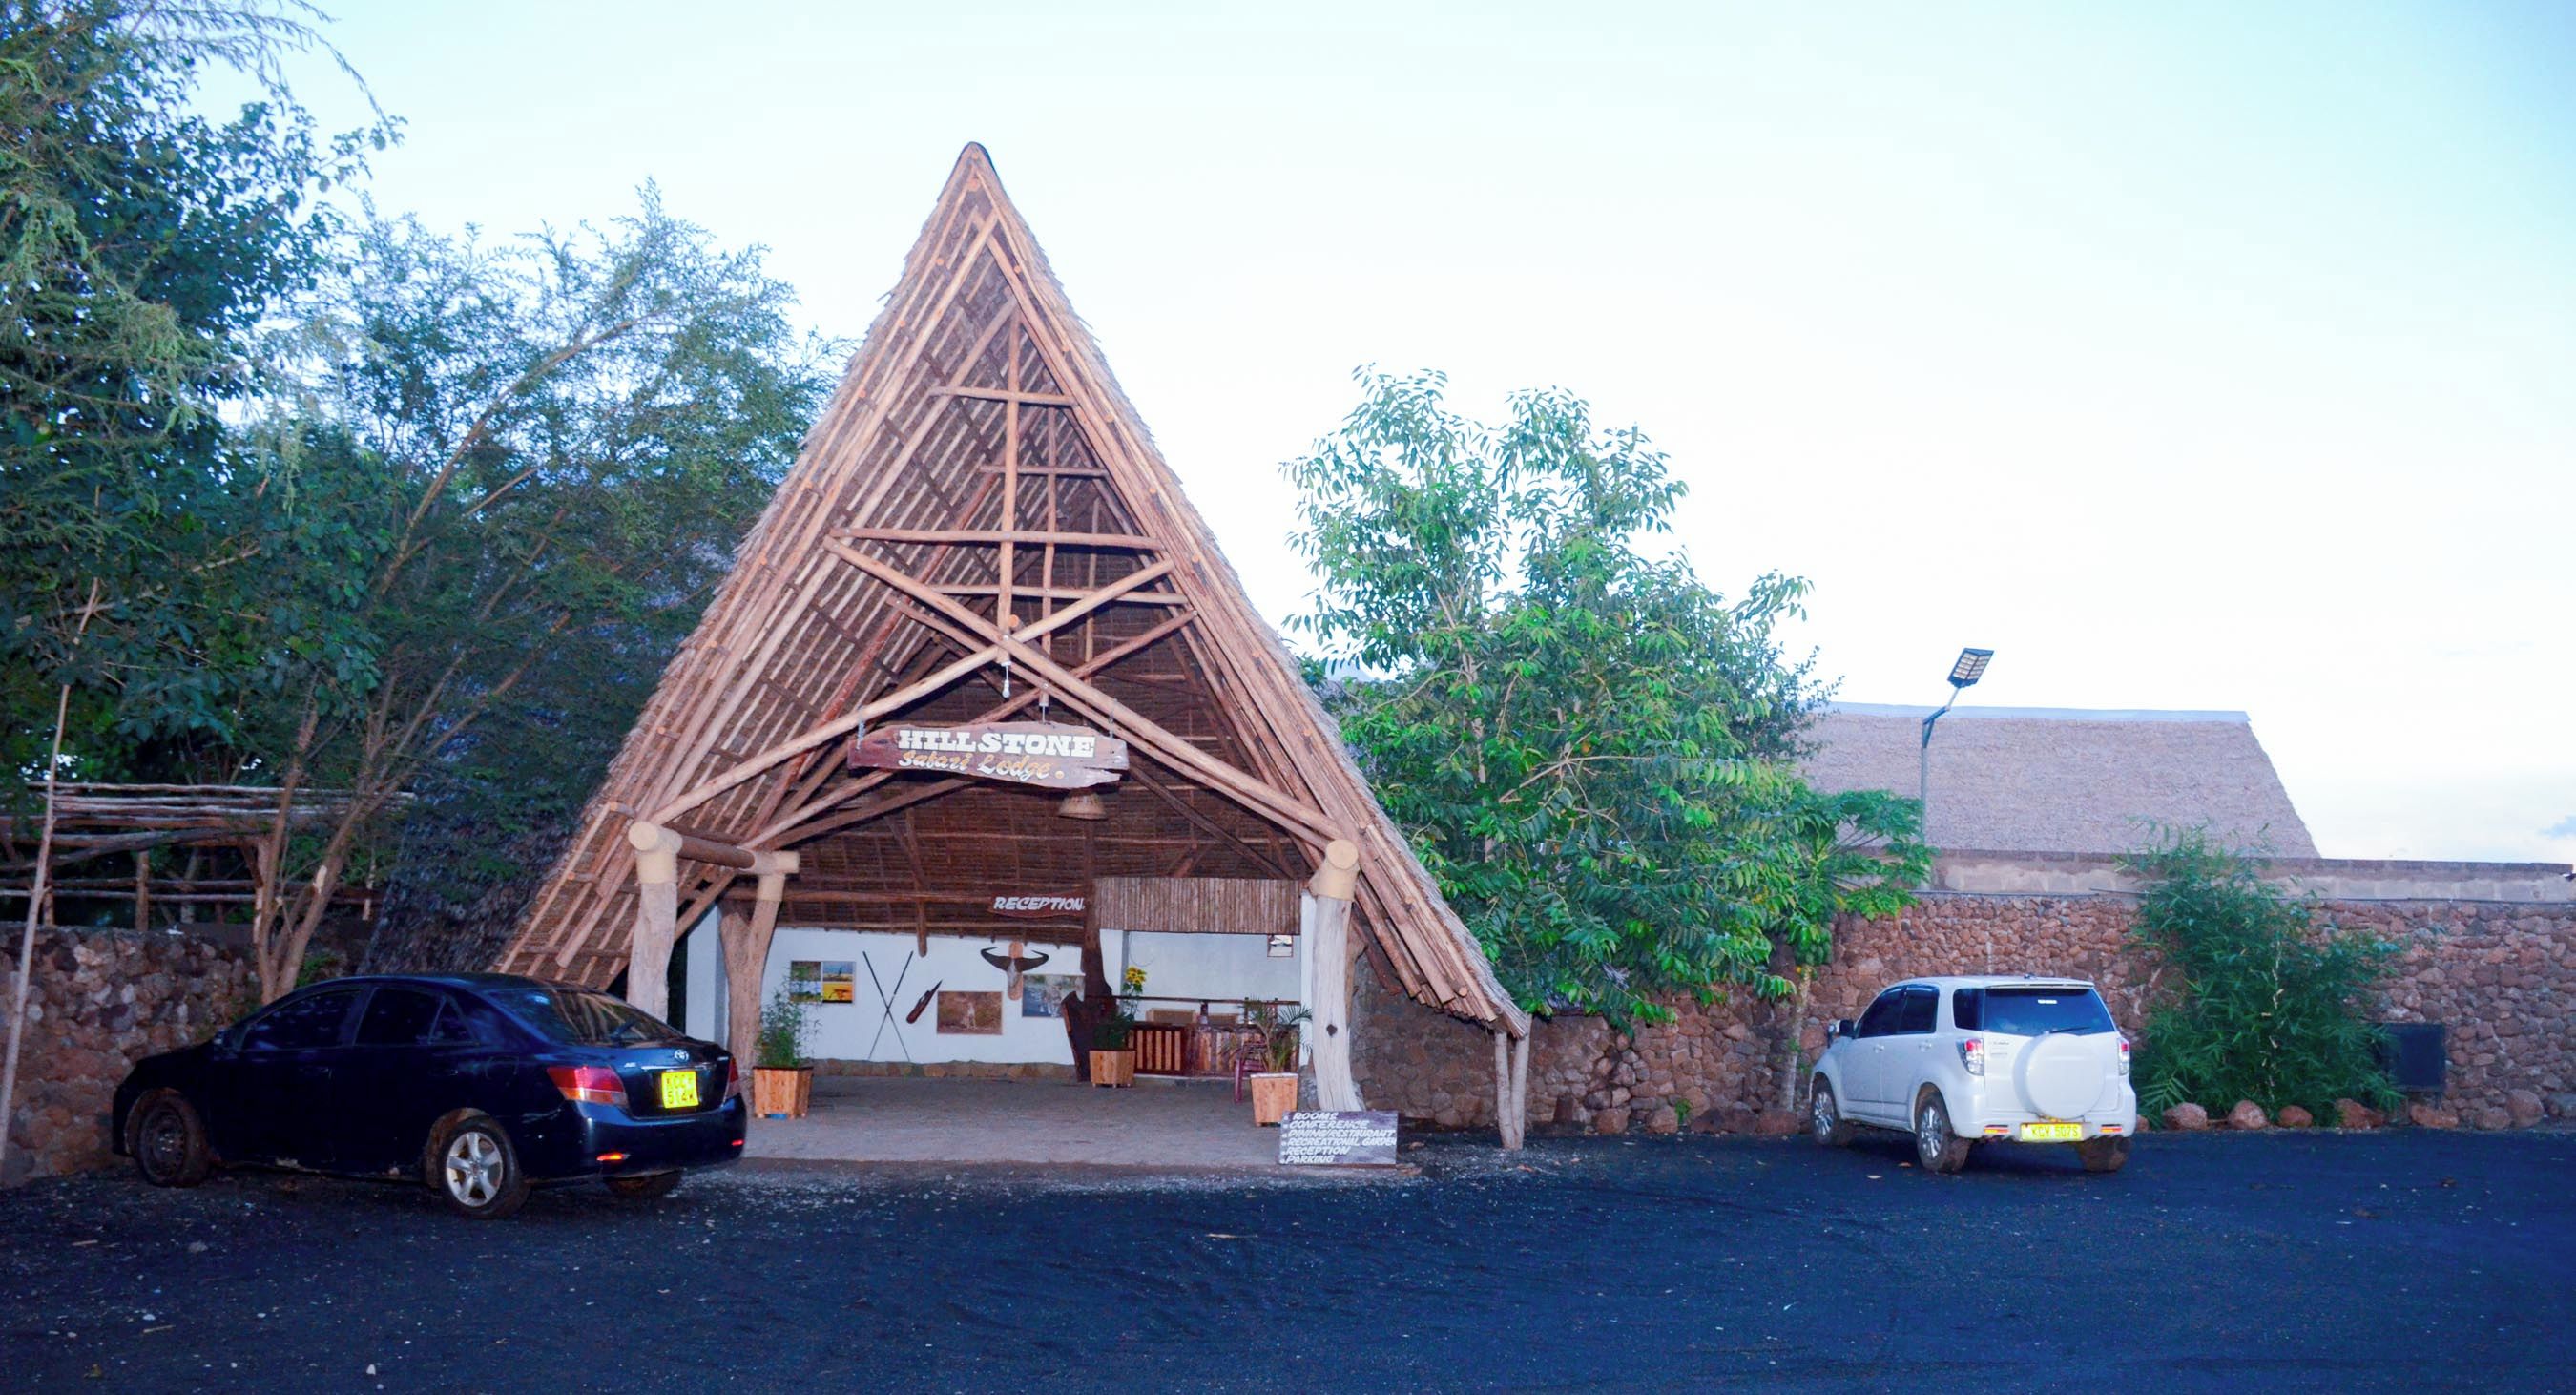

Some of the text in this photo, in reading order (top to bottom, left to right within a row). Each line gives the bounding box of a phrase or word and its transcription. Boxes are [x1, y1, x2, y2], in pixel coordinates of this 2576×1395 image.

[898, 730, 1096, 758] HILLSTONE
[898, 750, 973, 770] Safari
[1293, 1112, 1339, 1120] ROOMS
[1289, 1120, 1370, 1129] CONFERENCE
[1287, 1137, 1360, 1146] RECREATIONAL
[1285, 1146, 1351, 1155] RECEPTION
[1284, 1155, 1336, 1164] PARKING
